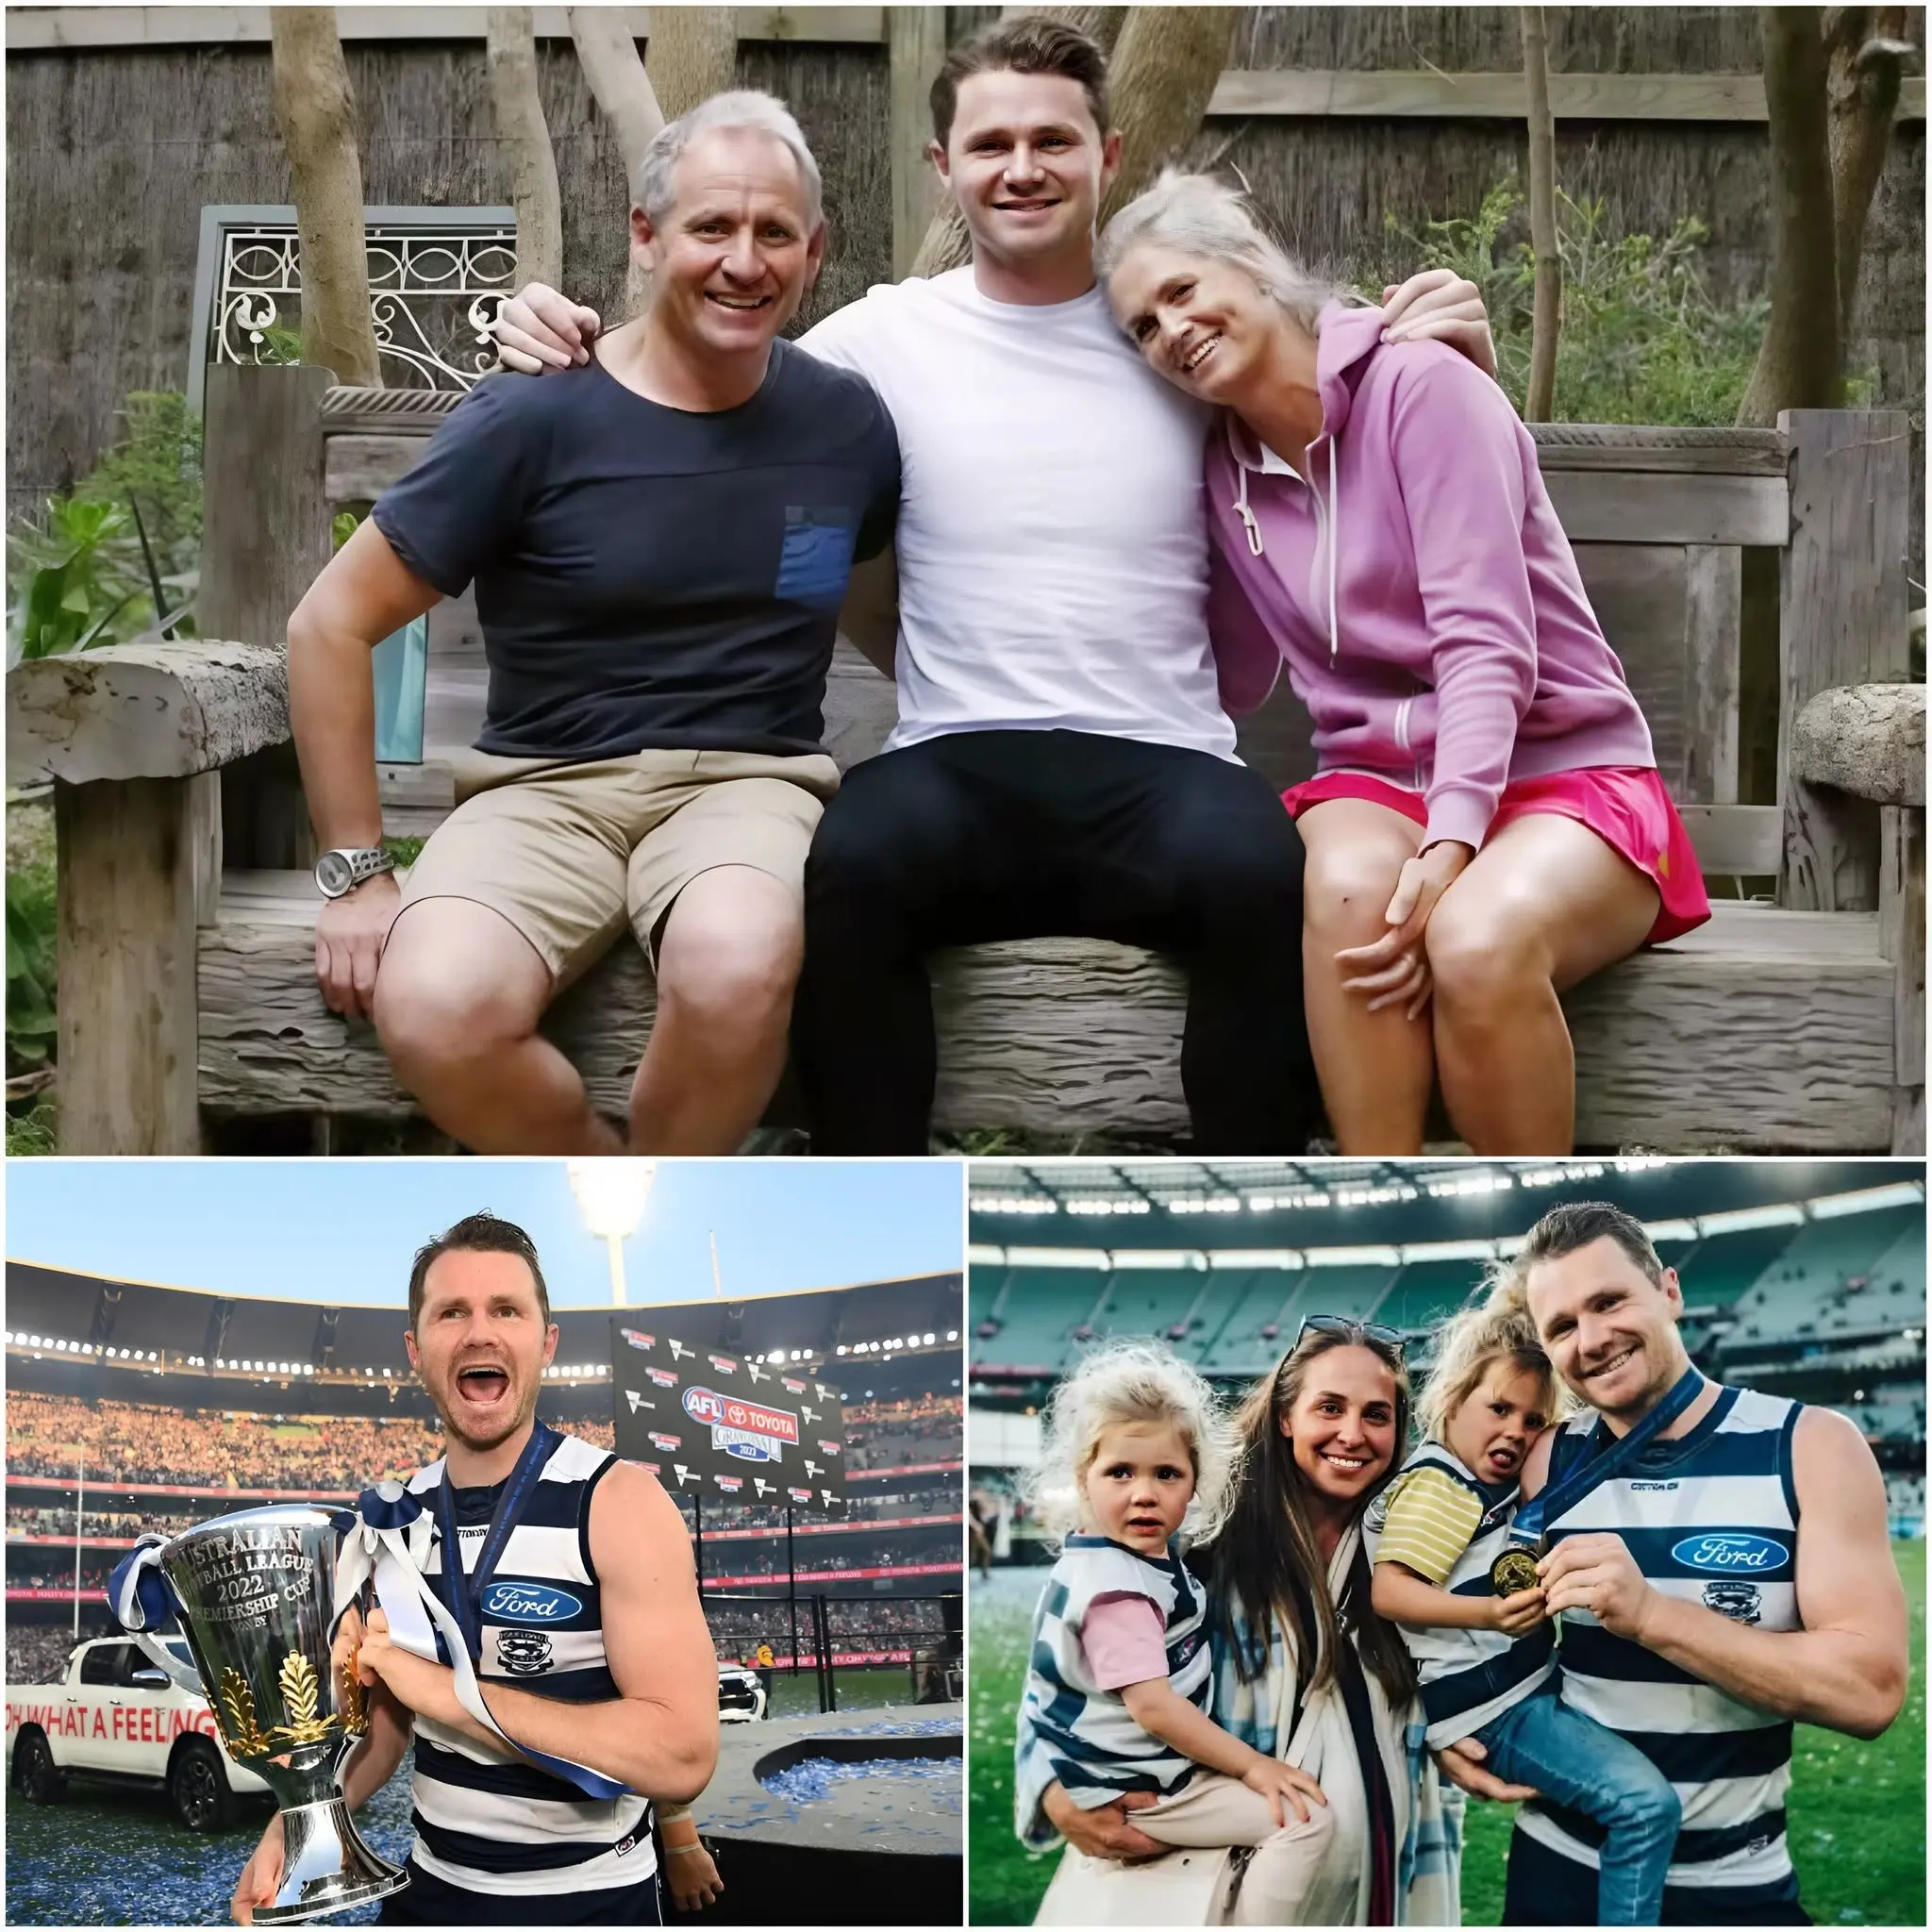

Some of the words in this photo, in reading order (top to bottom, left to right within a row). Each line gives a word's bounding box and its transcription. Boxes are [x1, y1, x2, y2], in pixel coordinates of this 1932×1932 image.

[687, 1394, 722, 1418] AFL
[748, 1412, 794, 1434] TOYOTA
[246, 1554, 314, 1574] LEAGUE
[1693, 1538, 1770, 1566] Ford
[217, 1574, 265, 1603] 2022
[284, 1575, 310, 1601] CUP
[489, 1586, 559, 1617] Ford
[26, 1705, 88, 1737] WHAT
[92, 1707, 107, 1740] A
[113, 1707, 216, 1743] FEELING
